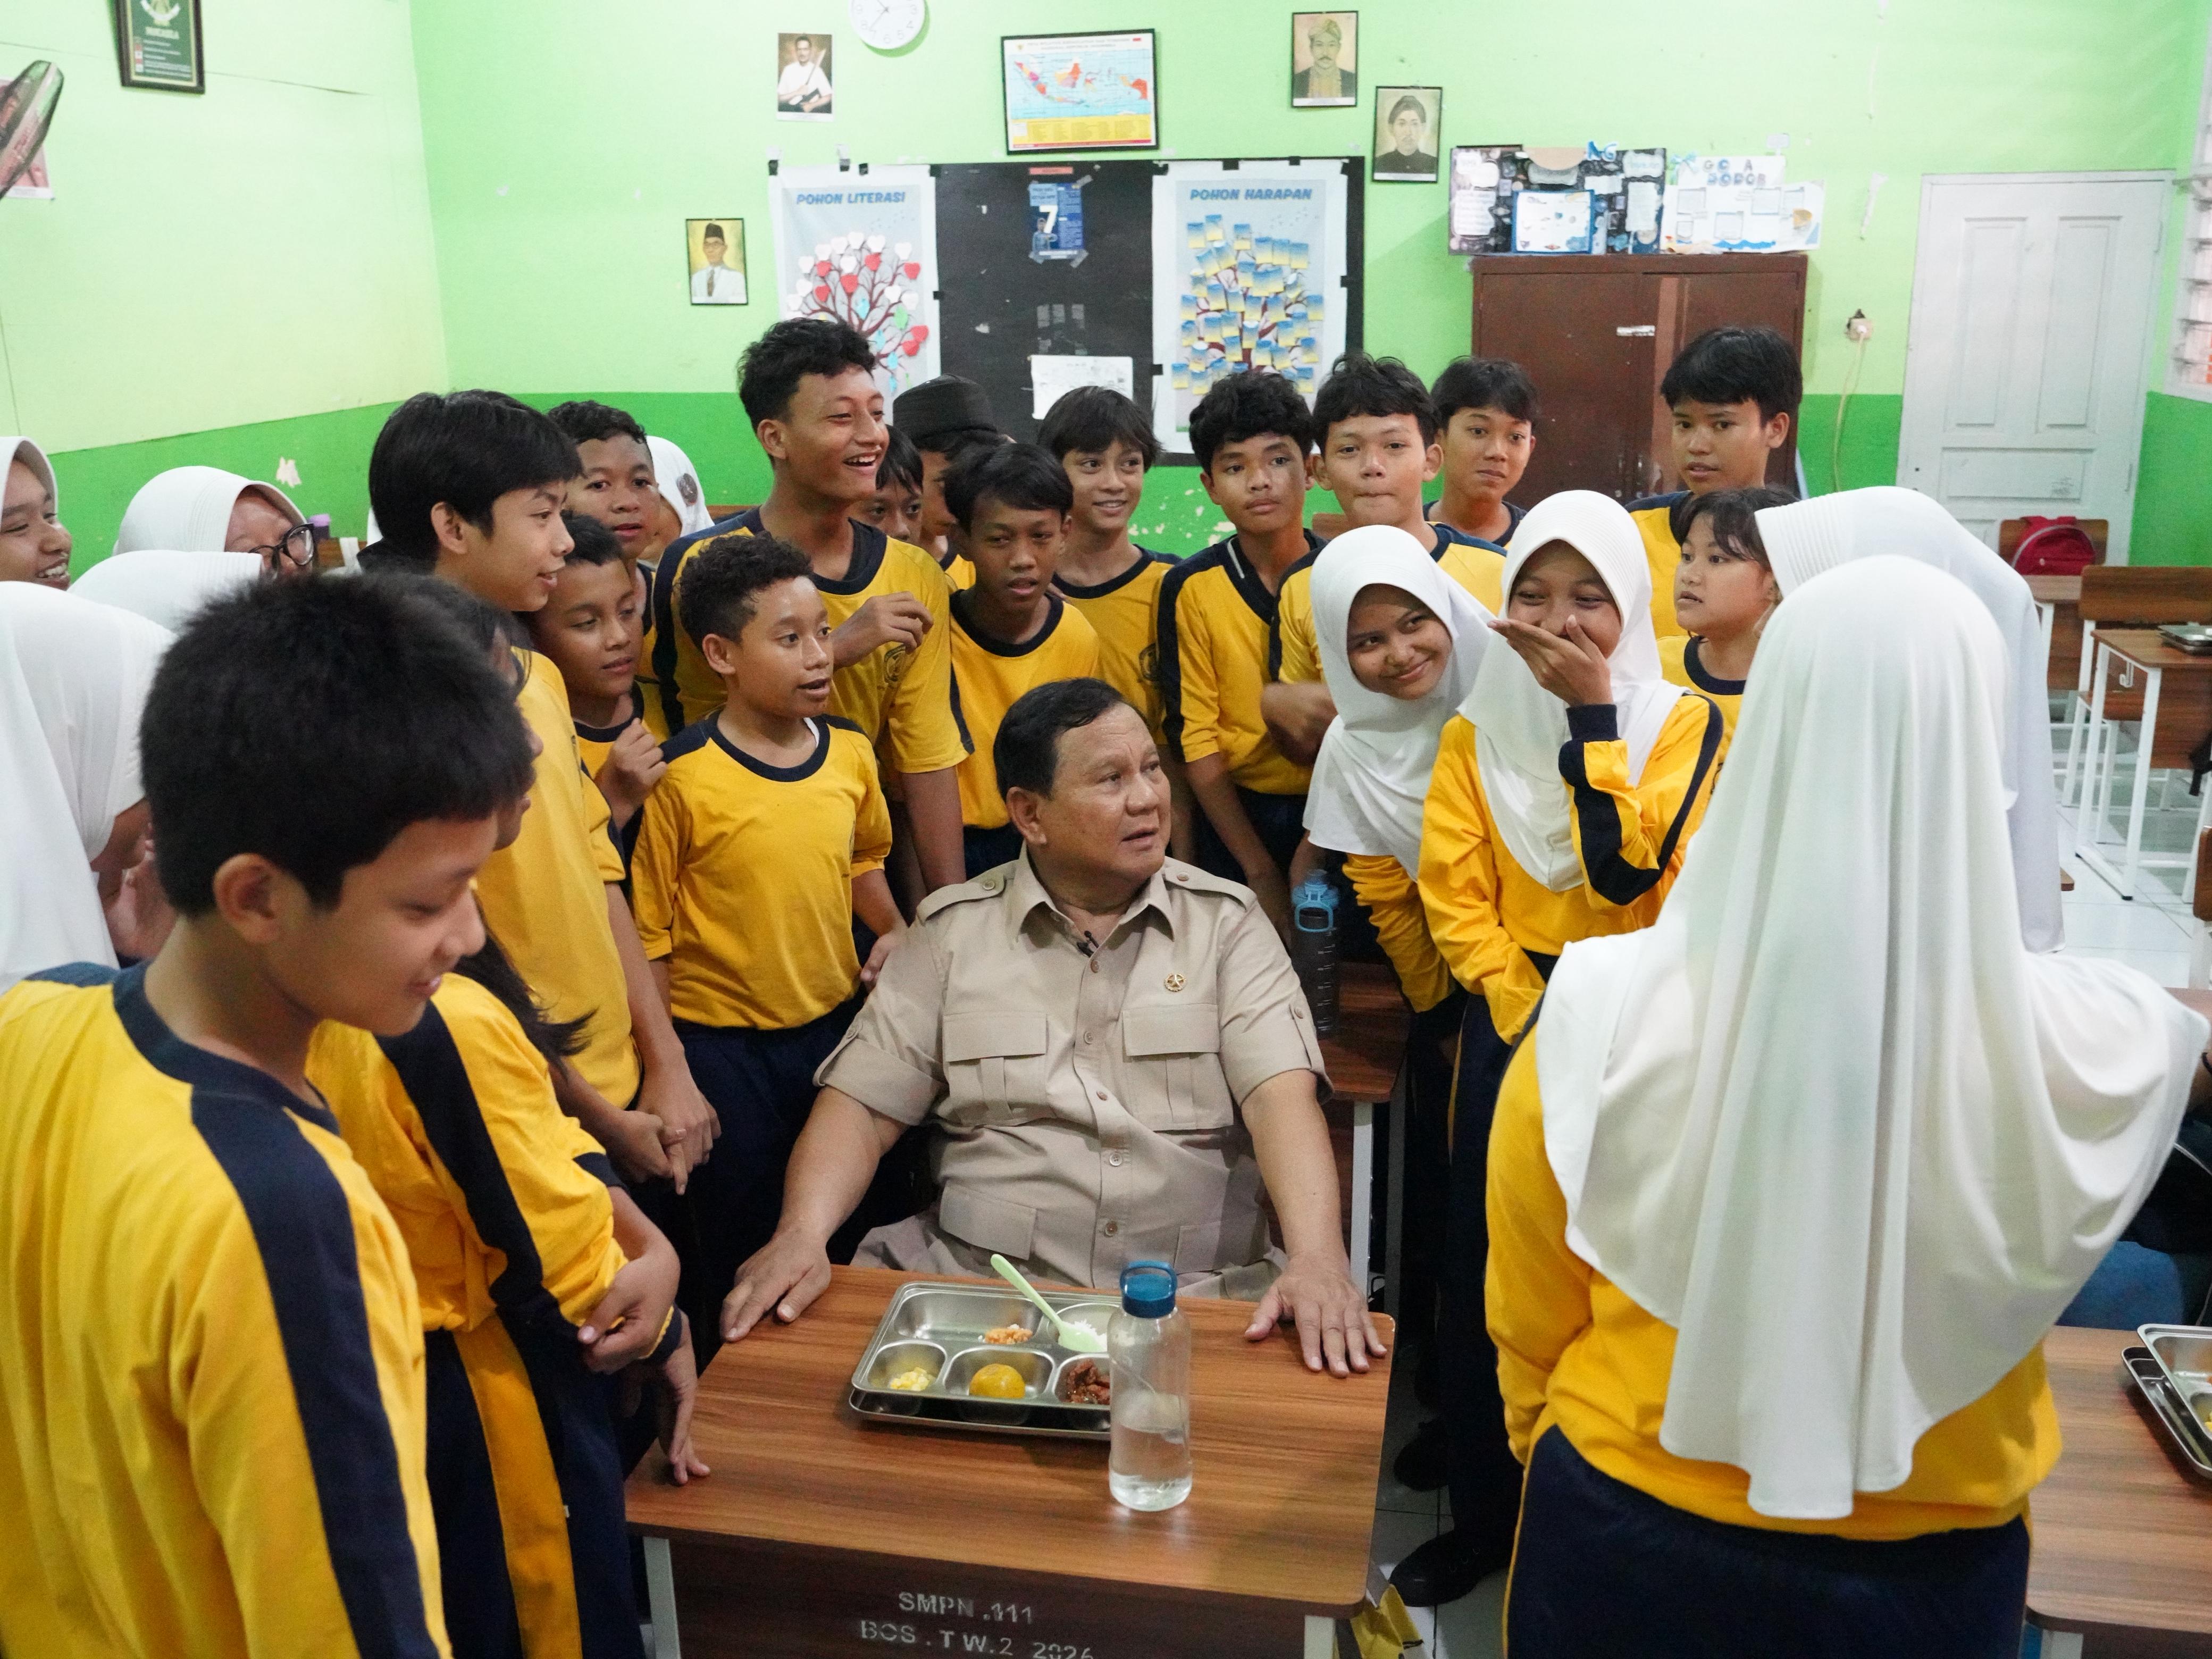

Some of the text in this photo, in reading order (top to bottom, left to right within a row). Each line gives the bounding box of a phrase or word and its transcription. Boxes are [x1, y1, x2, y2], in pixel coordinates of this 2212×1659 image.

[797, 191, 906, 205] POHON LITERASI
[1190, 188, 1313, 200] POHON HARAPAN
[1039, 205, 1058, 233] 7
